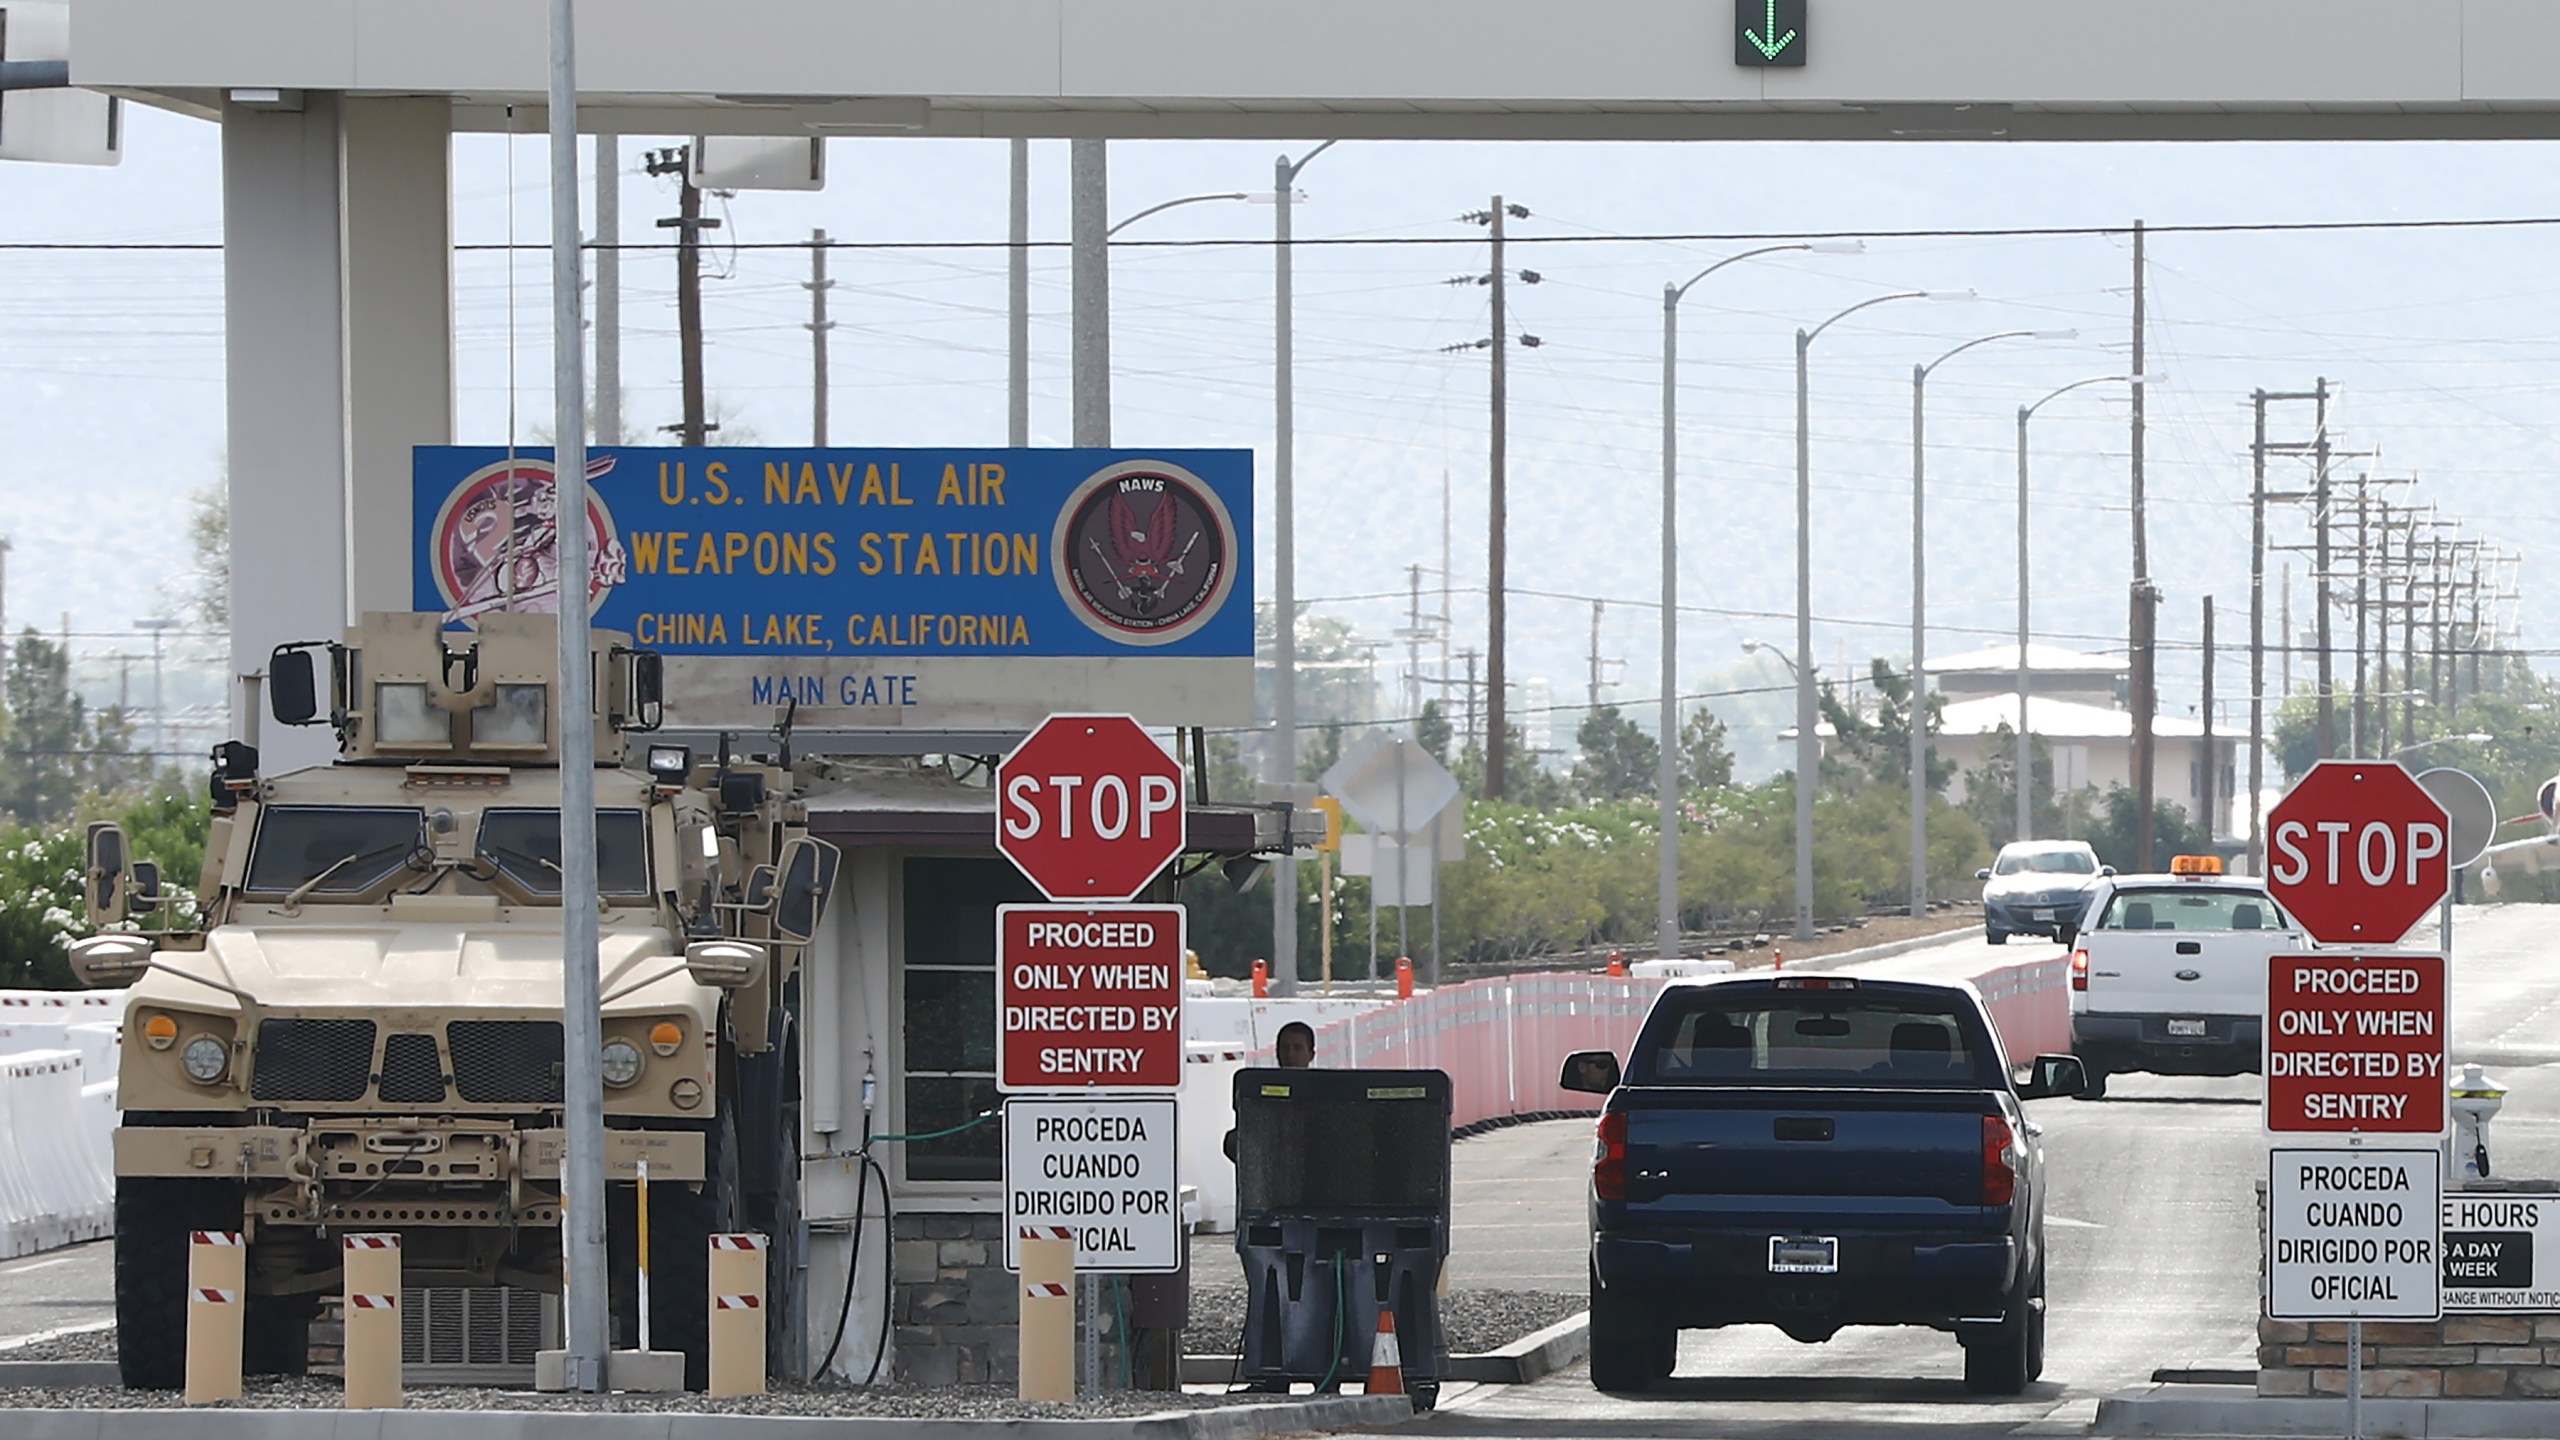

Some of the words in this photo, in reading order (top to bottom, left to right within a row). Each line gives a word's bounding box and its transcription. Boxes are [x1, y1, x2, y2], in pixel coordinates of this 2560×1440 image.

[659, 462, 743, 506] U.S.
[764, 462, 914, 506] NAVAL
[936, 463, 1007, 506] AIR
[1119, 478, 1166, 494] NAWS
[630, 532, 837, 577] WEAPONS
[859, 533, 1039, 577] STATION
[1092, 600, 1123, 624] WEAPONS
[1123, 617, 1153, 628] STATION
[1158, 612, 1180, 626] CHINA
[1195, 562, 1219, 603] CALIFORNIA
[636, 613, 728, 645] CHINA
[742, 614, 835, 652] LAKE,
[847, 614, 1031, 647] CALIFORNIA
[752, 676, 825, 706] MAIN
[840, 675, 918, 706] GATE
[1004, 774, 1178, 841] STOP
[2272, 821, 2444, 887] STOP
[1027, 922, 1154, 948] PROCEED
[1013, 964, 1085, 990] ONLY
[1090, 964, 1169, 990] WHEN
[2293, 968, 2420, 994] PROCEED
[1005, 1006, 1136, 1032] DIRECTED
[1142, 1006, 1179, 1032] BY
[2278, 1010, 2350, 1036] ONLY
[2355, 1010, 2433, 1036] WHEN
[1039, 1048, 1144, 1073] SENTRY
[2270, 1052, 2400, 1078] DIRECTED
[2406, 1052, 2443, 1078] BY
[2303, 1093, 2408, 1120] SENTRY
[1035, 1116, 1148, 1143] PROCEDA
[1042, 1153, 1140, 1179] CUANDO
[2299, 1165, 2411, 1192] PROCEDA
[1013, 1190, 1115, 1216] DIRIGIDO
[1122, 1190, 1170, 1215] POR
[2306, 1202, 2403, 1228] CUANDO
[2461, 1202, 2539, 1228] HOURS
[1075, 1226, 1137, 1252] ICIAL
[2277, 1238, 2378, 1264] DIRIGIDO
[2384, 1239, 2433, 1265] POR
[2451, 1242, 2465, 1258] A
[2468, 1242, 2503, 1258] DAY
[2449, 1261, 2499, 1278] WEEK
[2310, 1275, 2399, 1301] OFICIAL
[2479, 1291, 2526, 1305] WITHOUT
[2528, 1291, 2560, 1305] NOTIC
